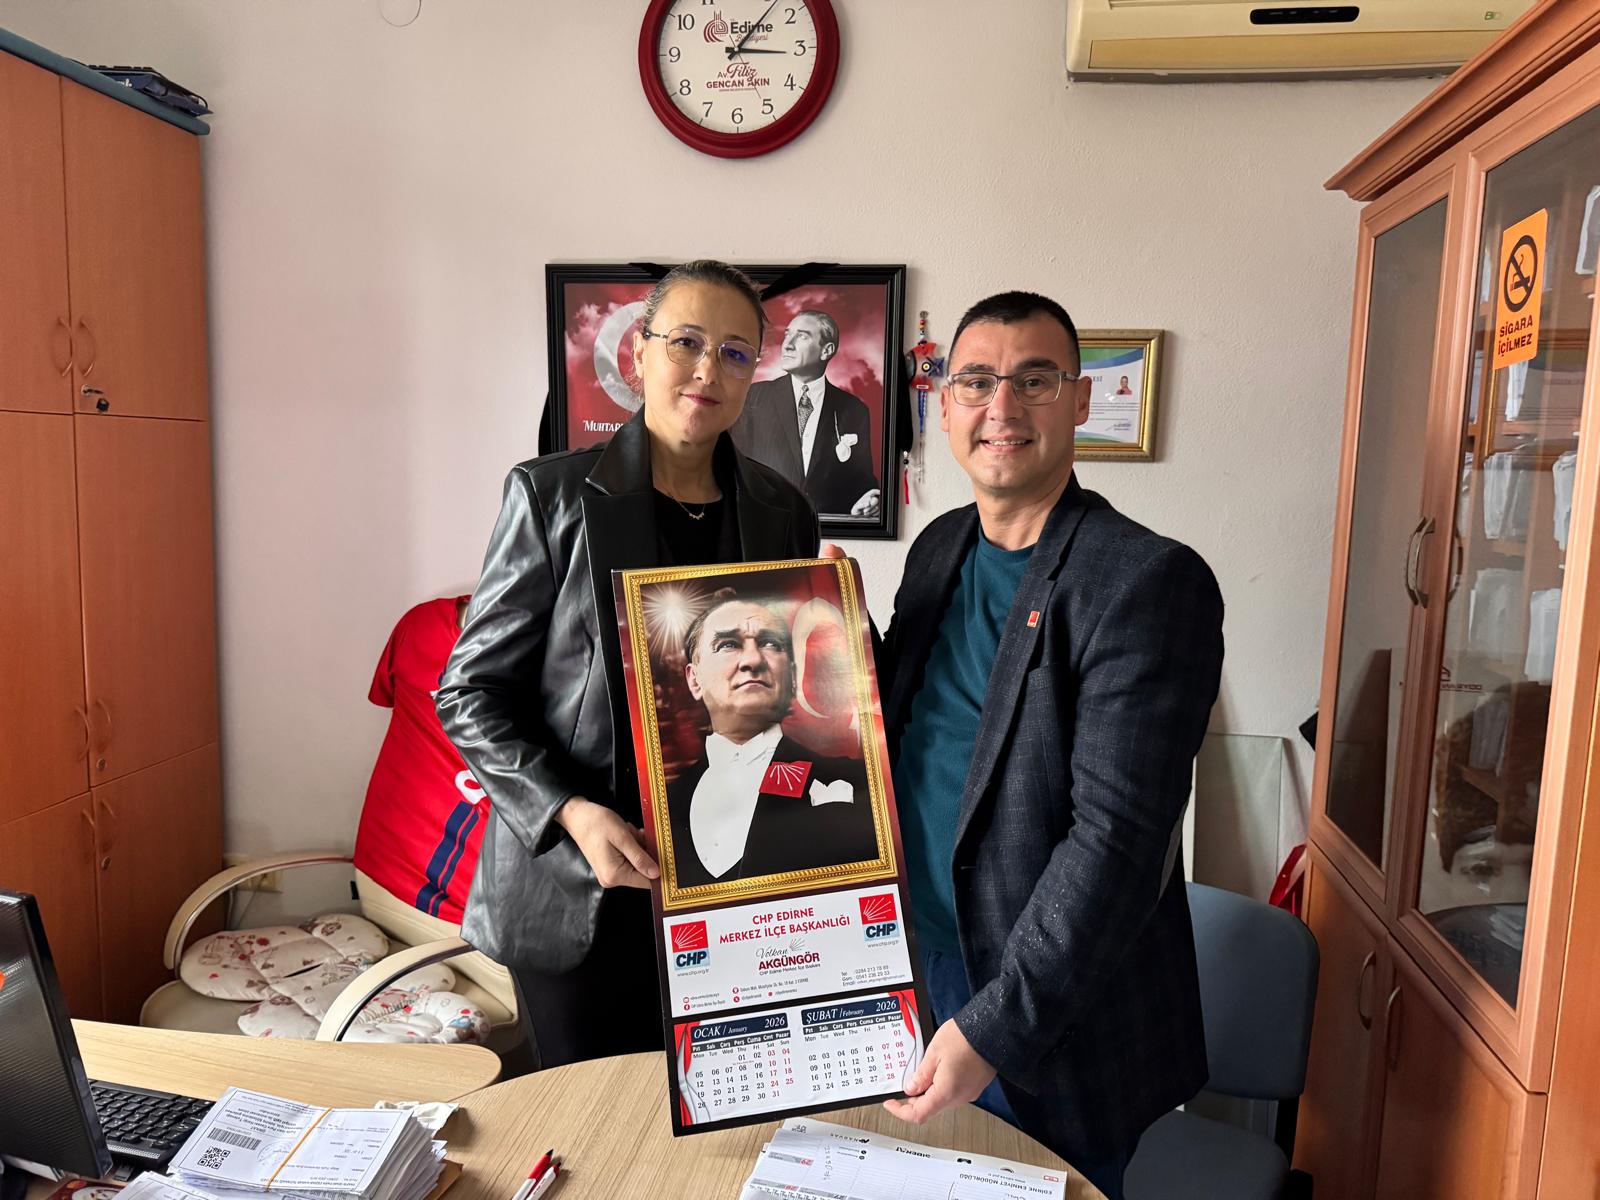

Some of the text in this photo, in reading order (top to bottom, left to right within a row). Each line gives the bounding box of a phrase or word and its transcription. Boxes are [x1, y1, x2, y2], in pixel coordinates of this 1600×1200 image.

[678, 14, 694, 30] 10
[784, 8, 796, 24] 2
[669, 47, 680, 62] 9
[794, 40, 806, 56] 3
[726, 62, 757, 82] Filiz
[680, 79, 691, 95] 8
[706, 78, 770, 88] GENCAN AKIN
[784, 74, 796, 90] 4
[702, 102, 712, 117] 7
[762, 99, 773, 114] 5
[732, 108, 743, 124] 6
[1500, 314, 1532, 337] SİGARA
[1498, 334, 1532, 357] İÇİLMEZ
[753, 908, 814, 925] CHP EDİRNE
[720, 915, 850, 944] MERKEZ İLÇE BAŞKANLIĞI
[866, 923, 896, 938] CHP
[676, 951, 706, 967] CHP
[756, 946, 788, 958] Volkan
[758, 951, 820, 970] AKGÜNGÖR
[806, 1008, 838, 1023] ŞUBAT
[876, 1000, 896, 1012] 2026
[694, 1026, 721, 1038] OCAK
[764, 1016, 785, 1028] 2026
